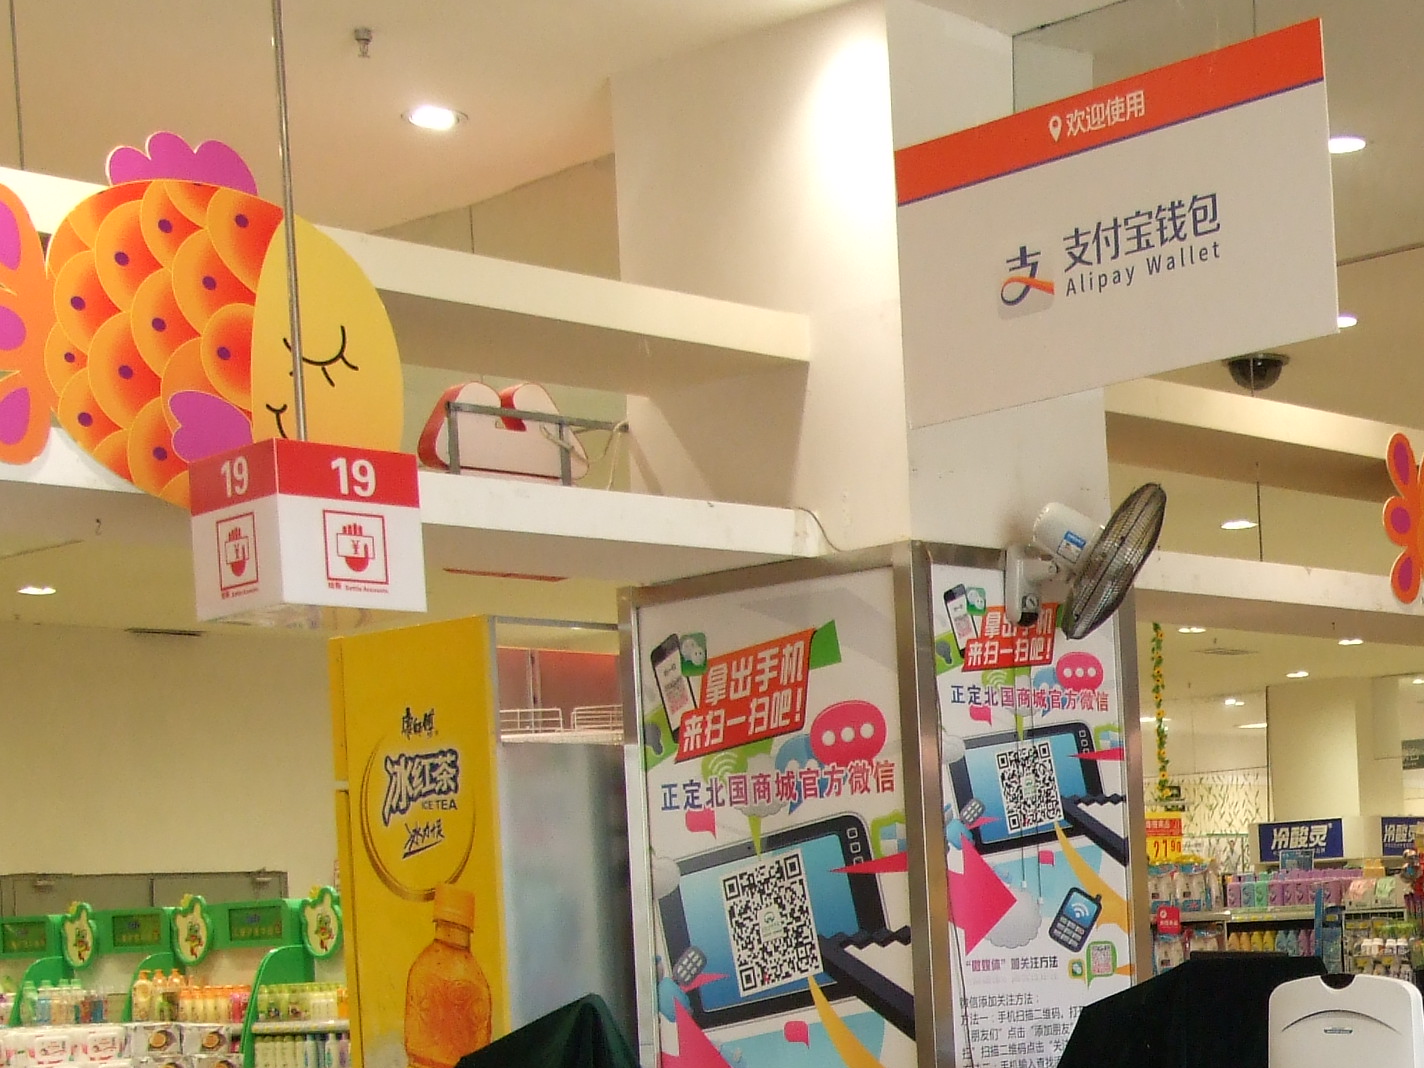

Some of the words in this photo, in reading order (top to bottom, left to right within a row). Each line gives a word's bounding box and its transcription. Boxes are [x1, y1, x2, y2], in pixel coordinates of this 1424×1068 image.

[1066, 90, 1145, 137] 欢迎使用
[1063, 193, 1220, 273] 支付宝钱包
[1066, 265, 1135, 296] Alipay
[1146, 241, 1220, 275] Wallet
[220, 455, 249, 498] 19
[330, 457, 377, 497] 19
[706, 641, 804, 705] 拿出手机
[951, 684, 1109, 712] 正定北国商城官方微信
[382, 749, 460, 827] 冰红茶
[434, 799, 458, 811] TEA
[661, 760, 895, 811] 正定北国商城官方微信
[1271, 824, 1328, 850] 冷酸灵
